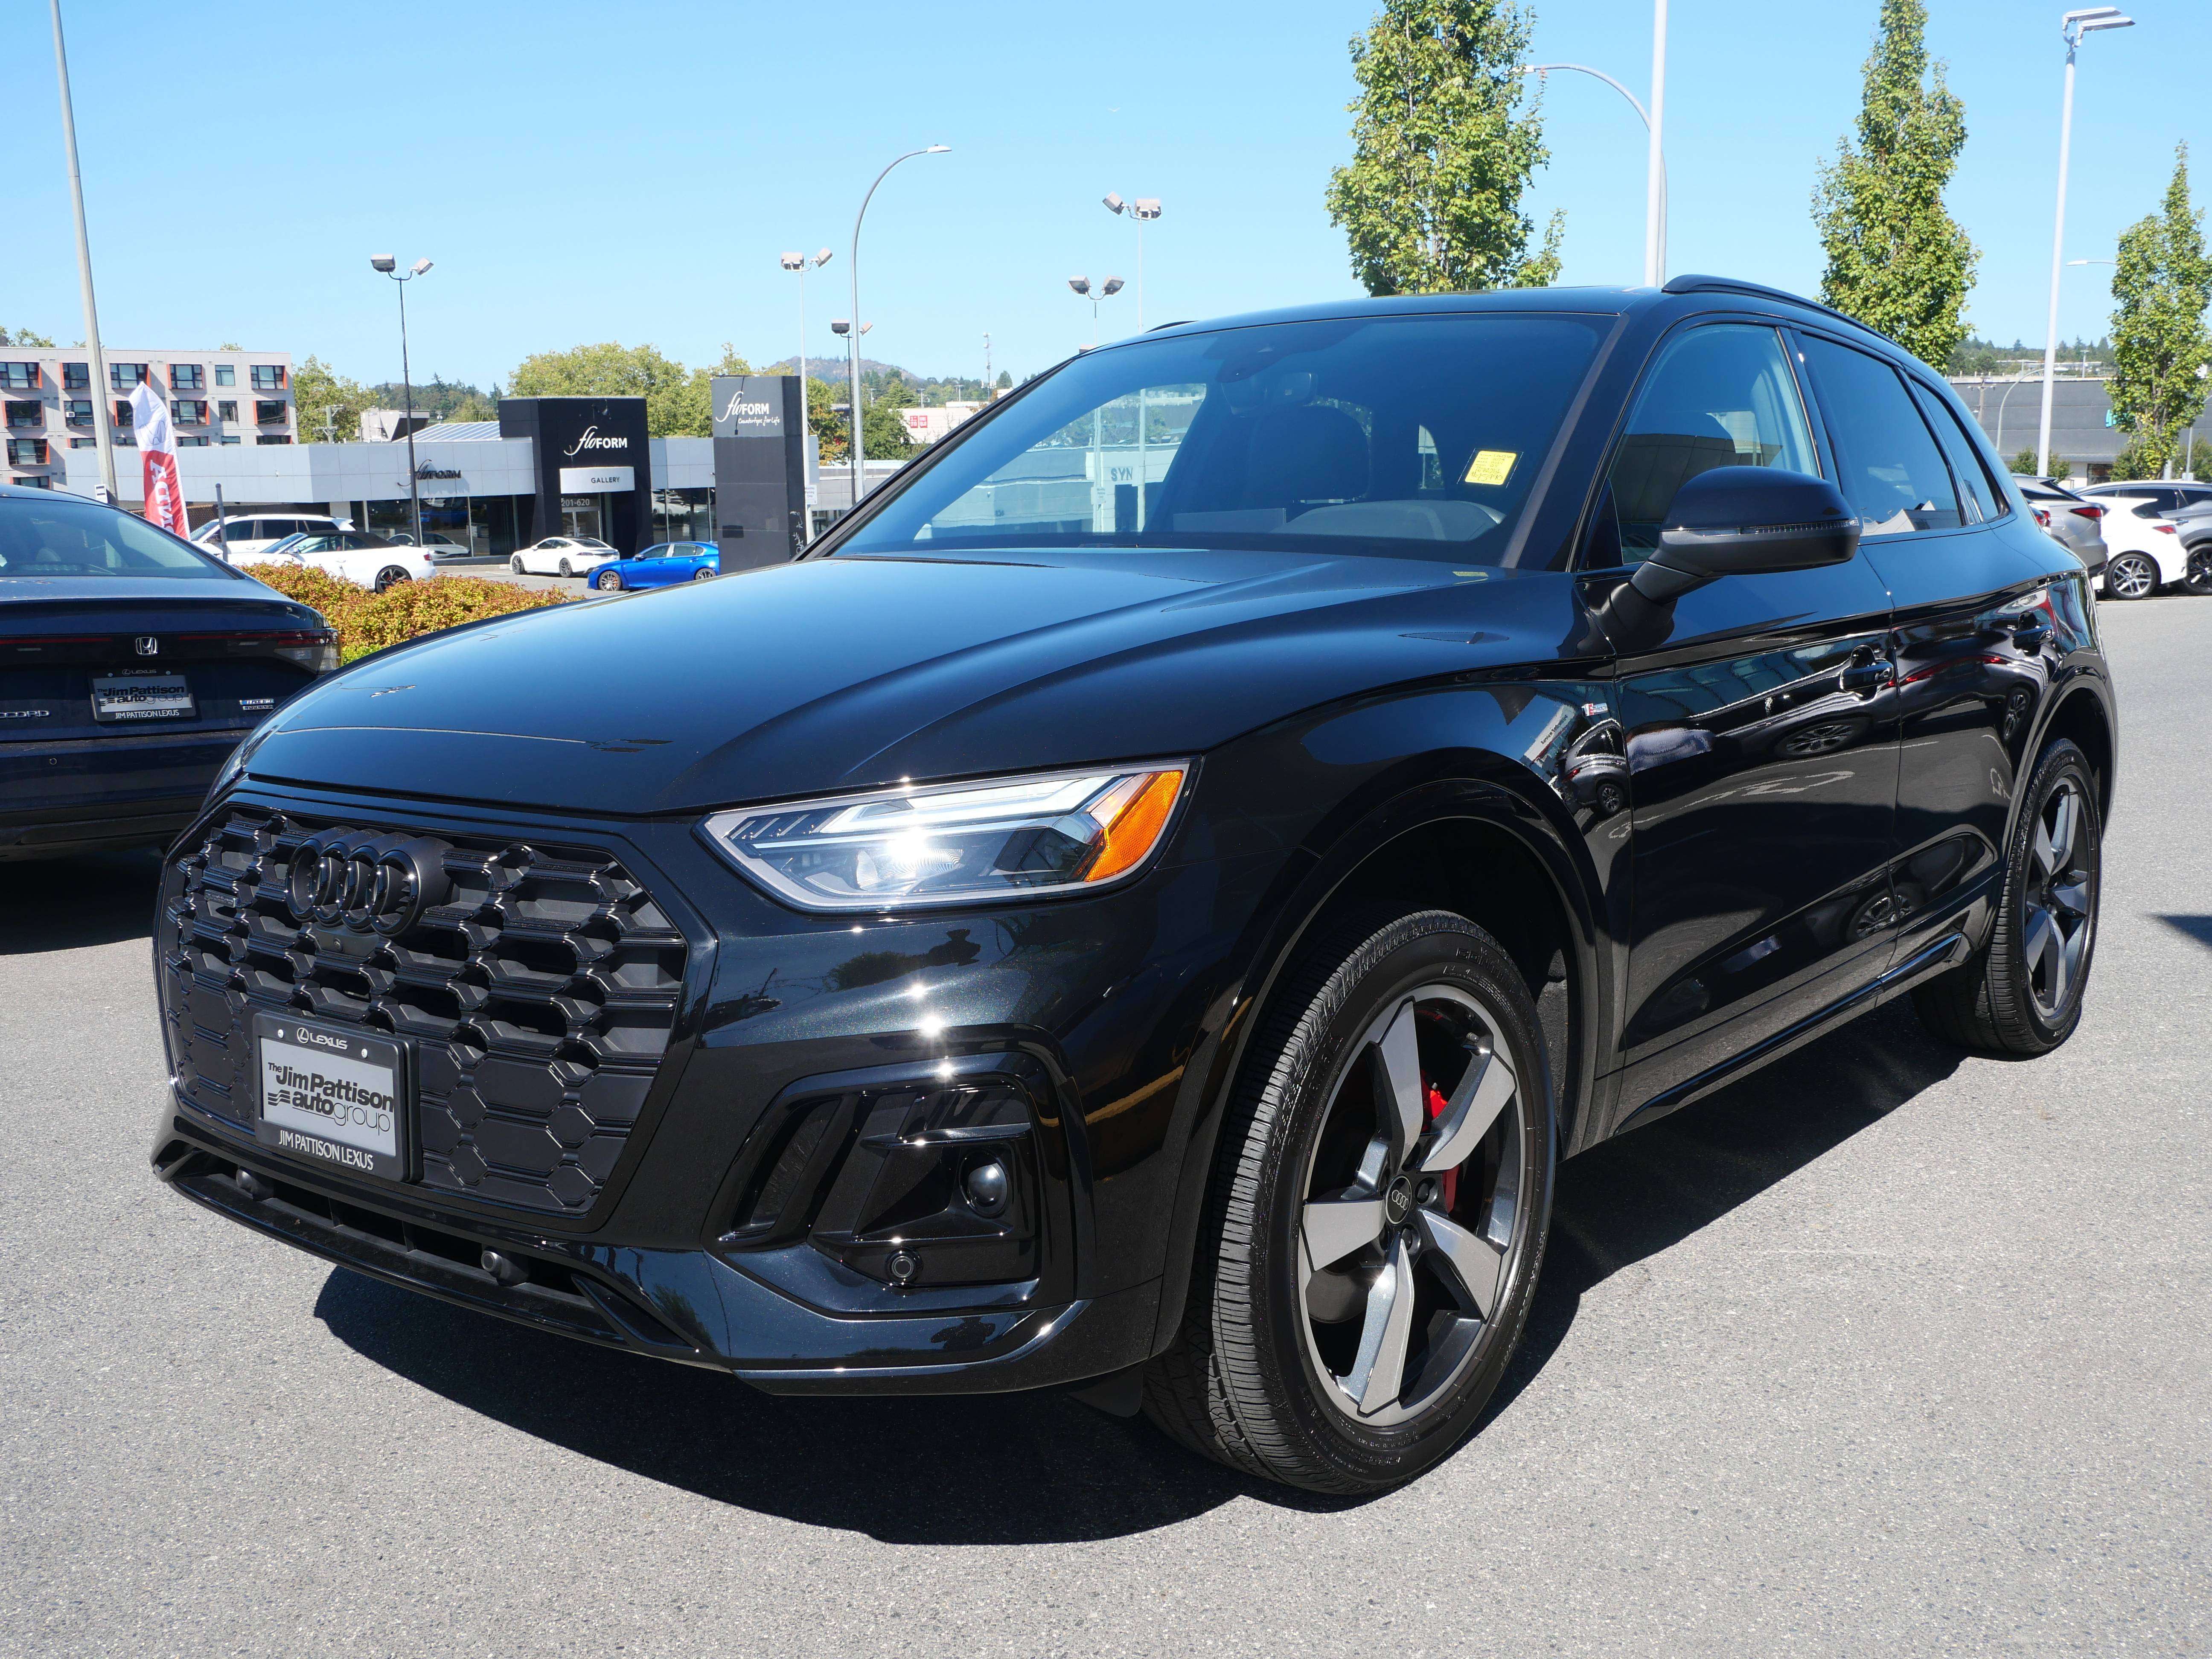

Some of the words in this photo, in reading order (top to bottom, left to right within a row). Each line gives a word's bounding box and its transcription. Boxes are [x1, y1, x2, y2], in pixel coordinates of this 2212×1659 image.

[564, 426, 627, 456] floFORM
[104, 687, 128, 696] Jim
[129, 685, 185, 695] Pattison
[116, 694, 183, 704] autogroup
[128, 710, 158, 719] PATTISON
[310, 1033, 348, 1050] LEXUS
[268, 1062, 282, 1073] The
[276, 1065, 309, 1091] Jim
[310, 1073, 394, 1113] Pattison
[292, 1090, 390, 1136] autogroup
[279, 1130, 294, 1148] JIM
[295, 1134, 340, 1161] PATTISON
[341, 1147, 374, 1170] LEXUS
